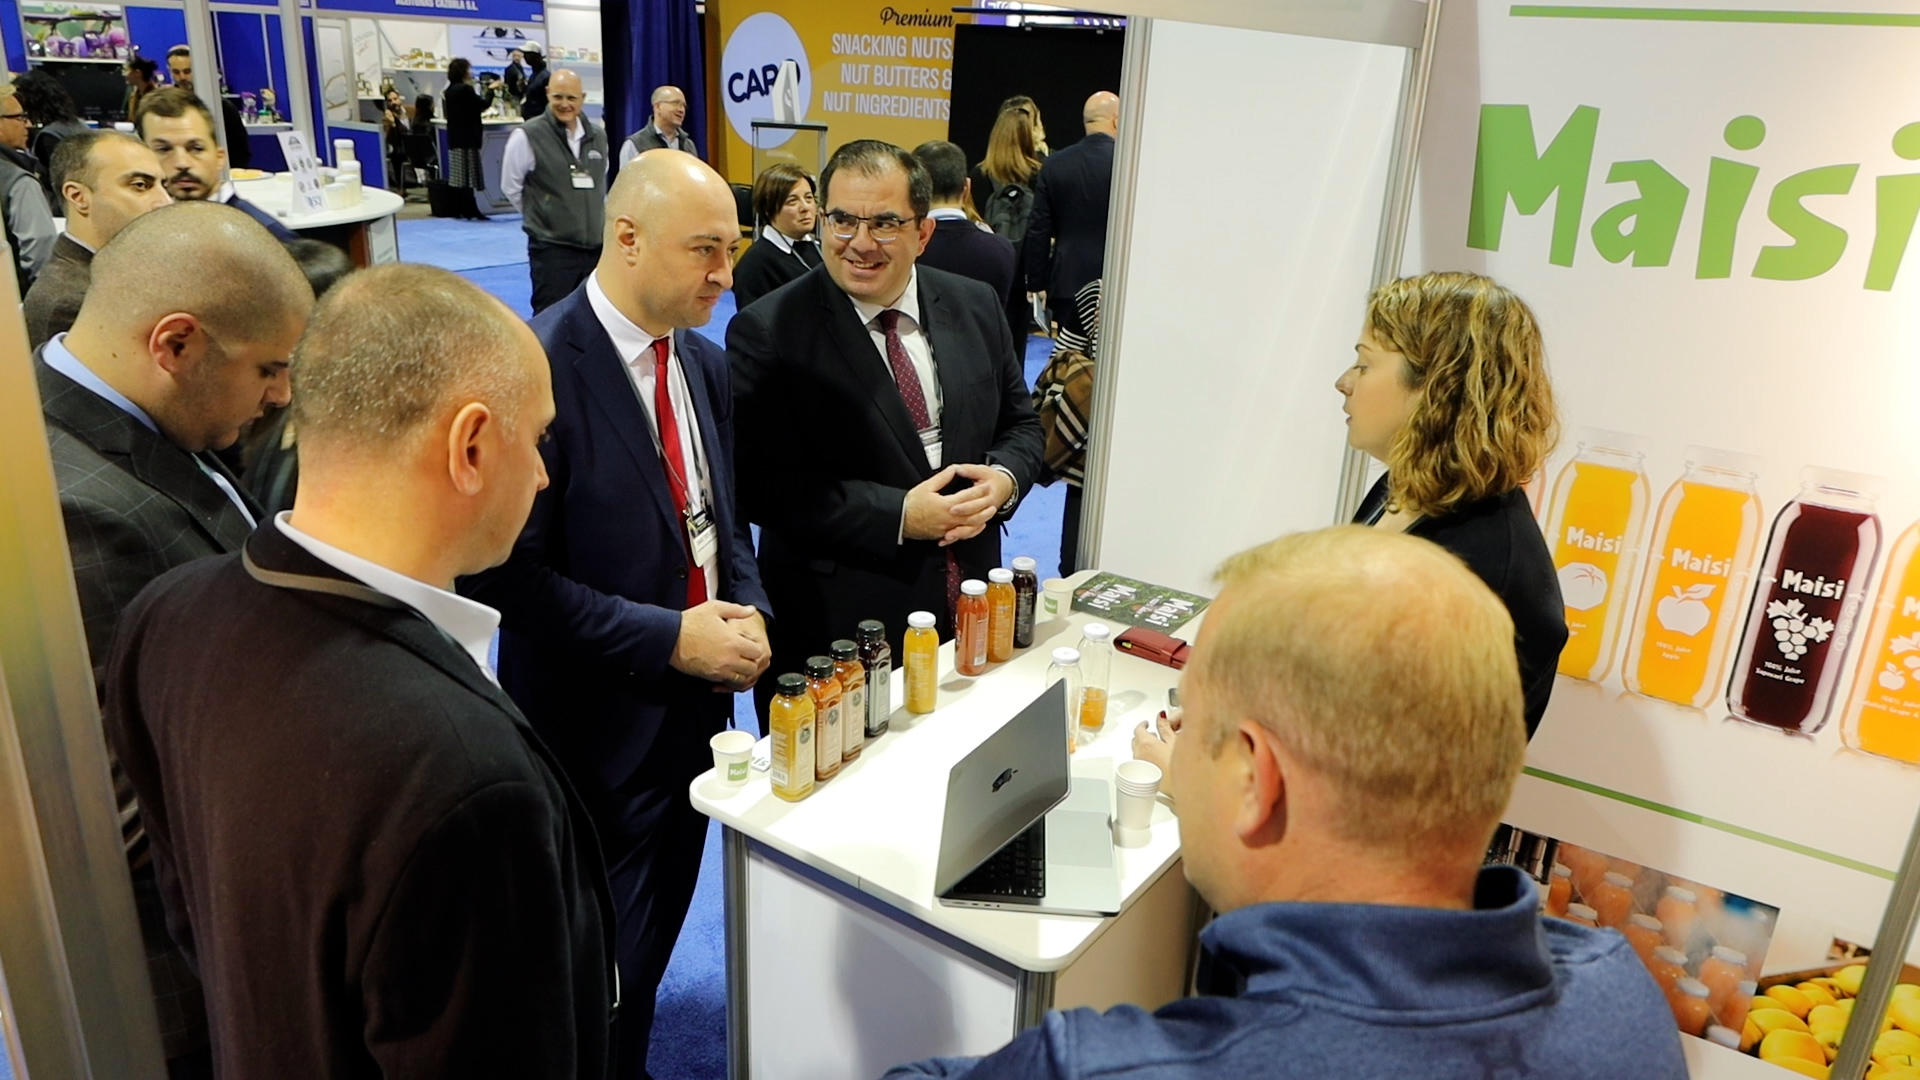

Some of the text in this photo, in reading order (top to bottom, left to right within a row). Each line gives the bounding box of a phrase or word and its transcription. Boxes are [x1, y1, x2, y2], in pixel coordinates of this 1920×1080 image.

[880, 6, 953, 27] Premium
[832, 33, 907, 57] SNACKING
[841, 63, 952, 90] NUT BUTTERS &
[823, 91, 950, 121] NUT INGREDIENTS
[1466, 104, 1920, 292] Maisi
[1566, 525, 1624, 555] Maisi
[1671, 548, 1732, 577] Maisi
[1087, 583, 1137, 611] Maisi
[1781, 569, 1845, 599] Maisi
[1145, 598, 1194, 627] Maisi
